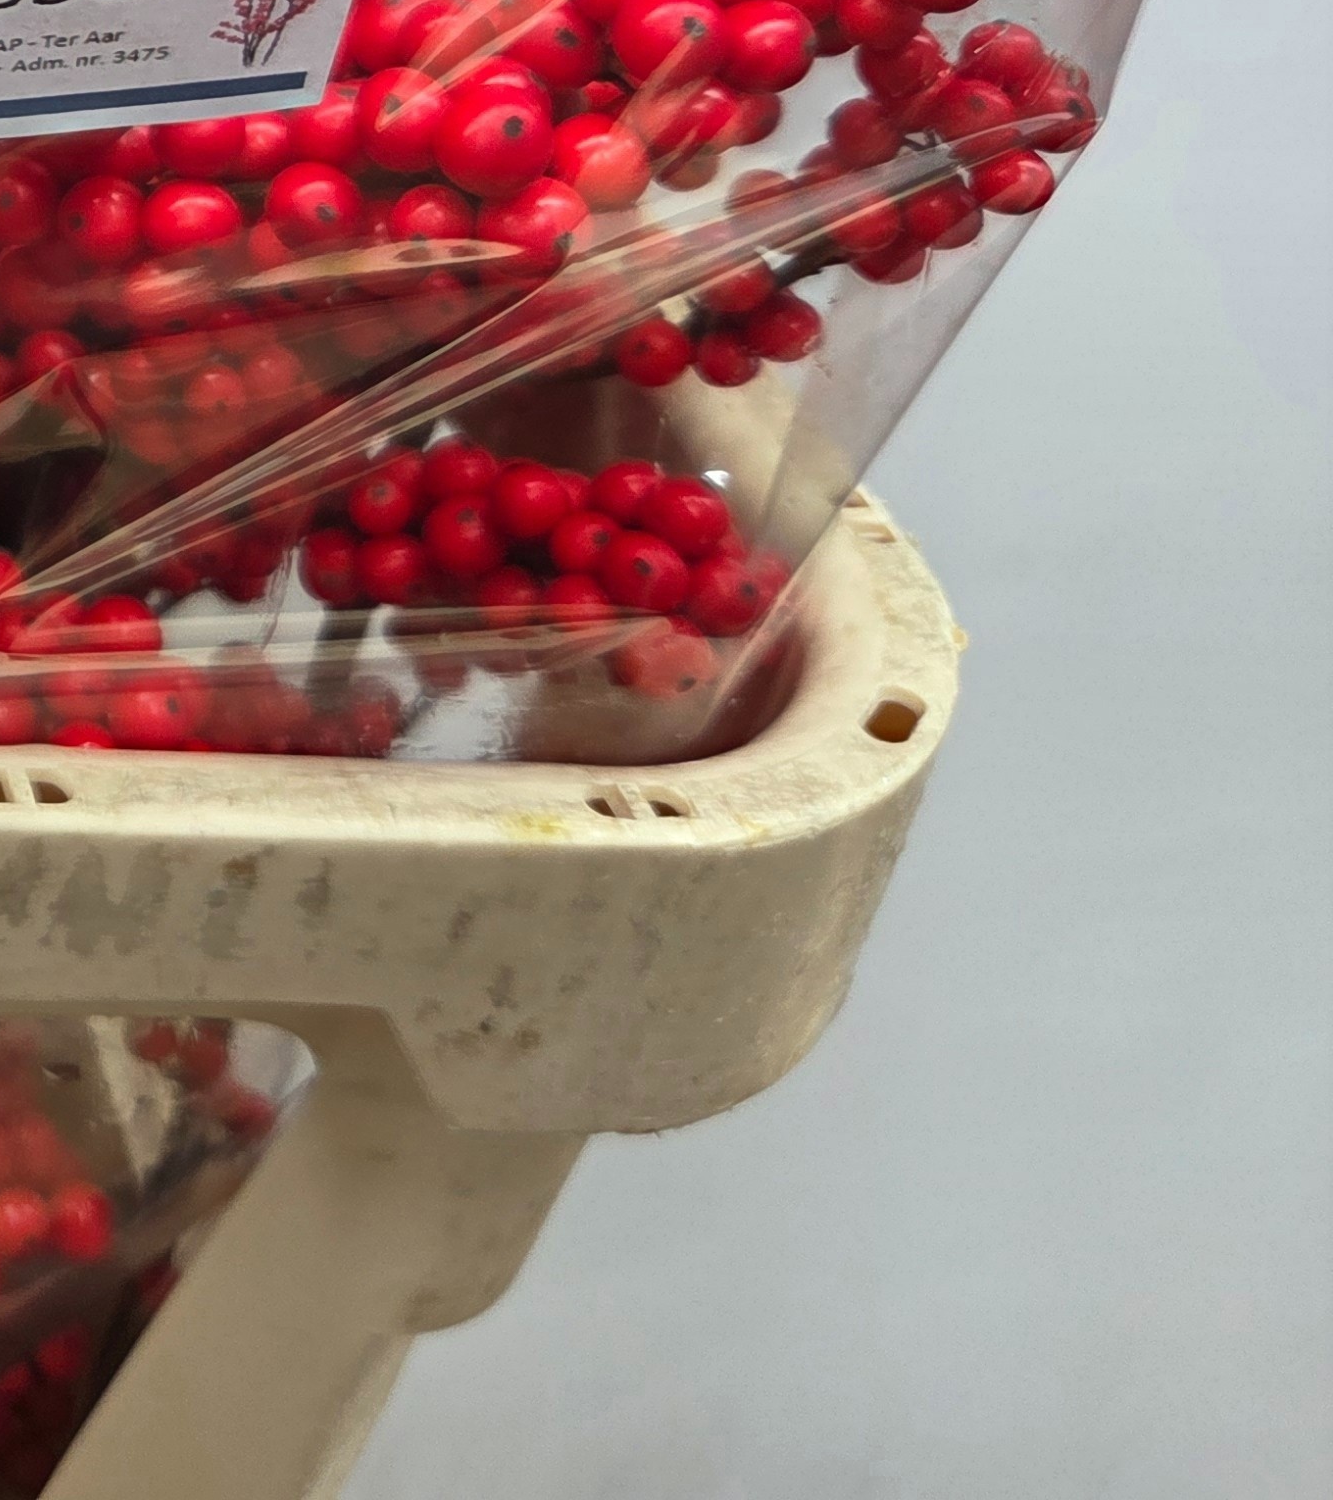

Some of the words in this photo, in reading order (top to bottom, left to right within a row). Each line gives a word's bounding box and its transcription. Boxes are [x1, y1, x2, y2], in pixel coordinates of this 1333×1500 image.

[41, 33, 81, 49] Ter
[84, 30, 127, 45] Aar
[11, 57, 69, 73] Adm.
[75, 53, 106, 68] nr.
[112, 46, 171, 65] 3475
